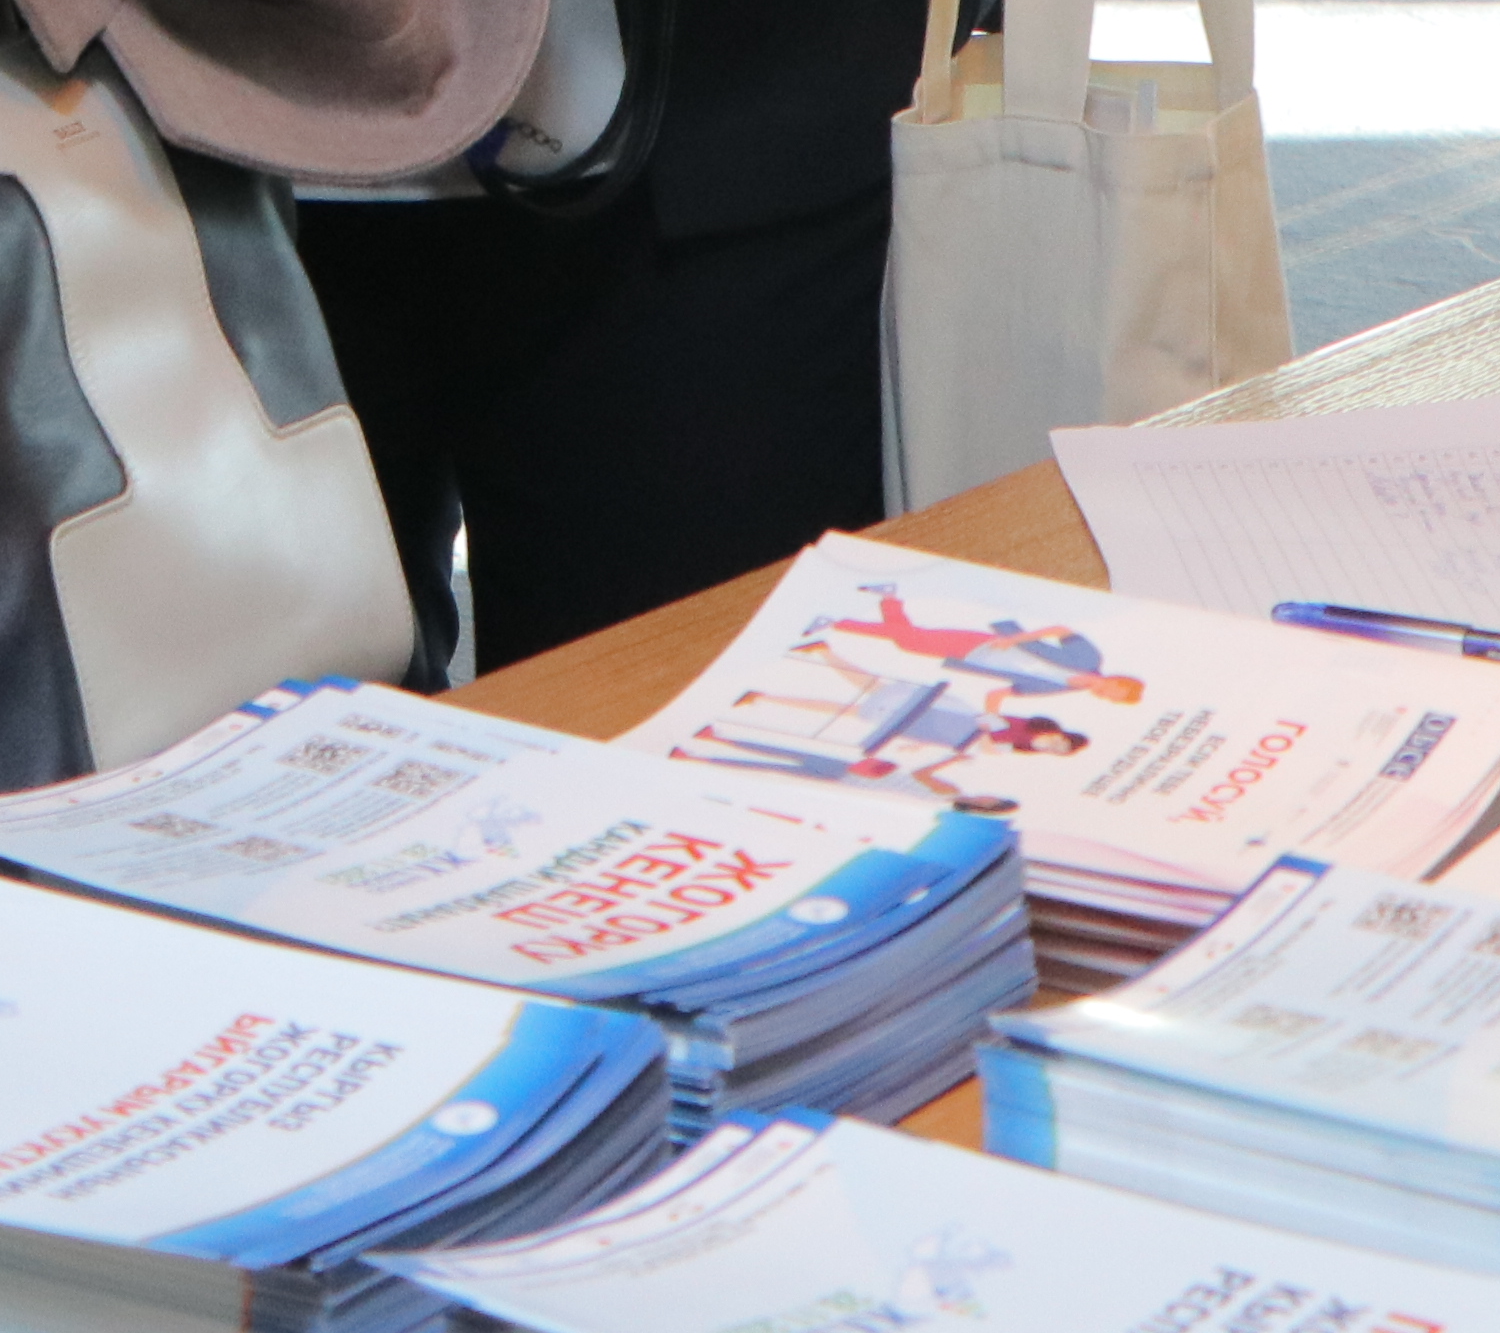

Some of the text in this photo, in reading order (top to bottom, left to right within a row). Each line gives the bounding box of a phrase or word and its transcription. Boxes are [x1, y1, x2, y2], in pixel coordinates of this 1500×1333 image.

[508, 850, 793, 965] ЖОГОРКУ
[98, 1013, 274, 1120] ЫЙГАРЫМ
[173, 1020, 316, 1118] ЖОГОРКУ
[266, 1041, 403, 1133] КЫРГЫЗ
